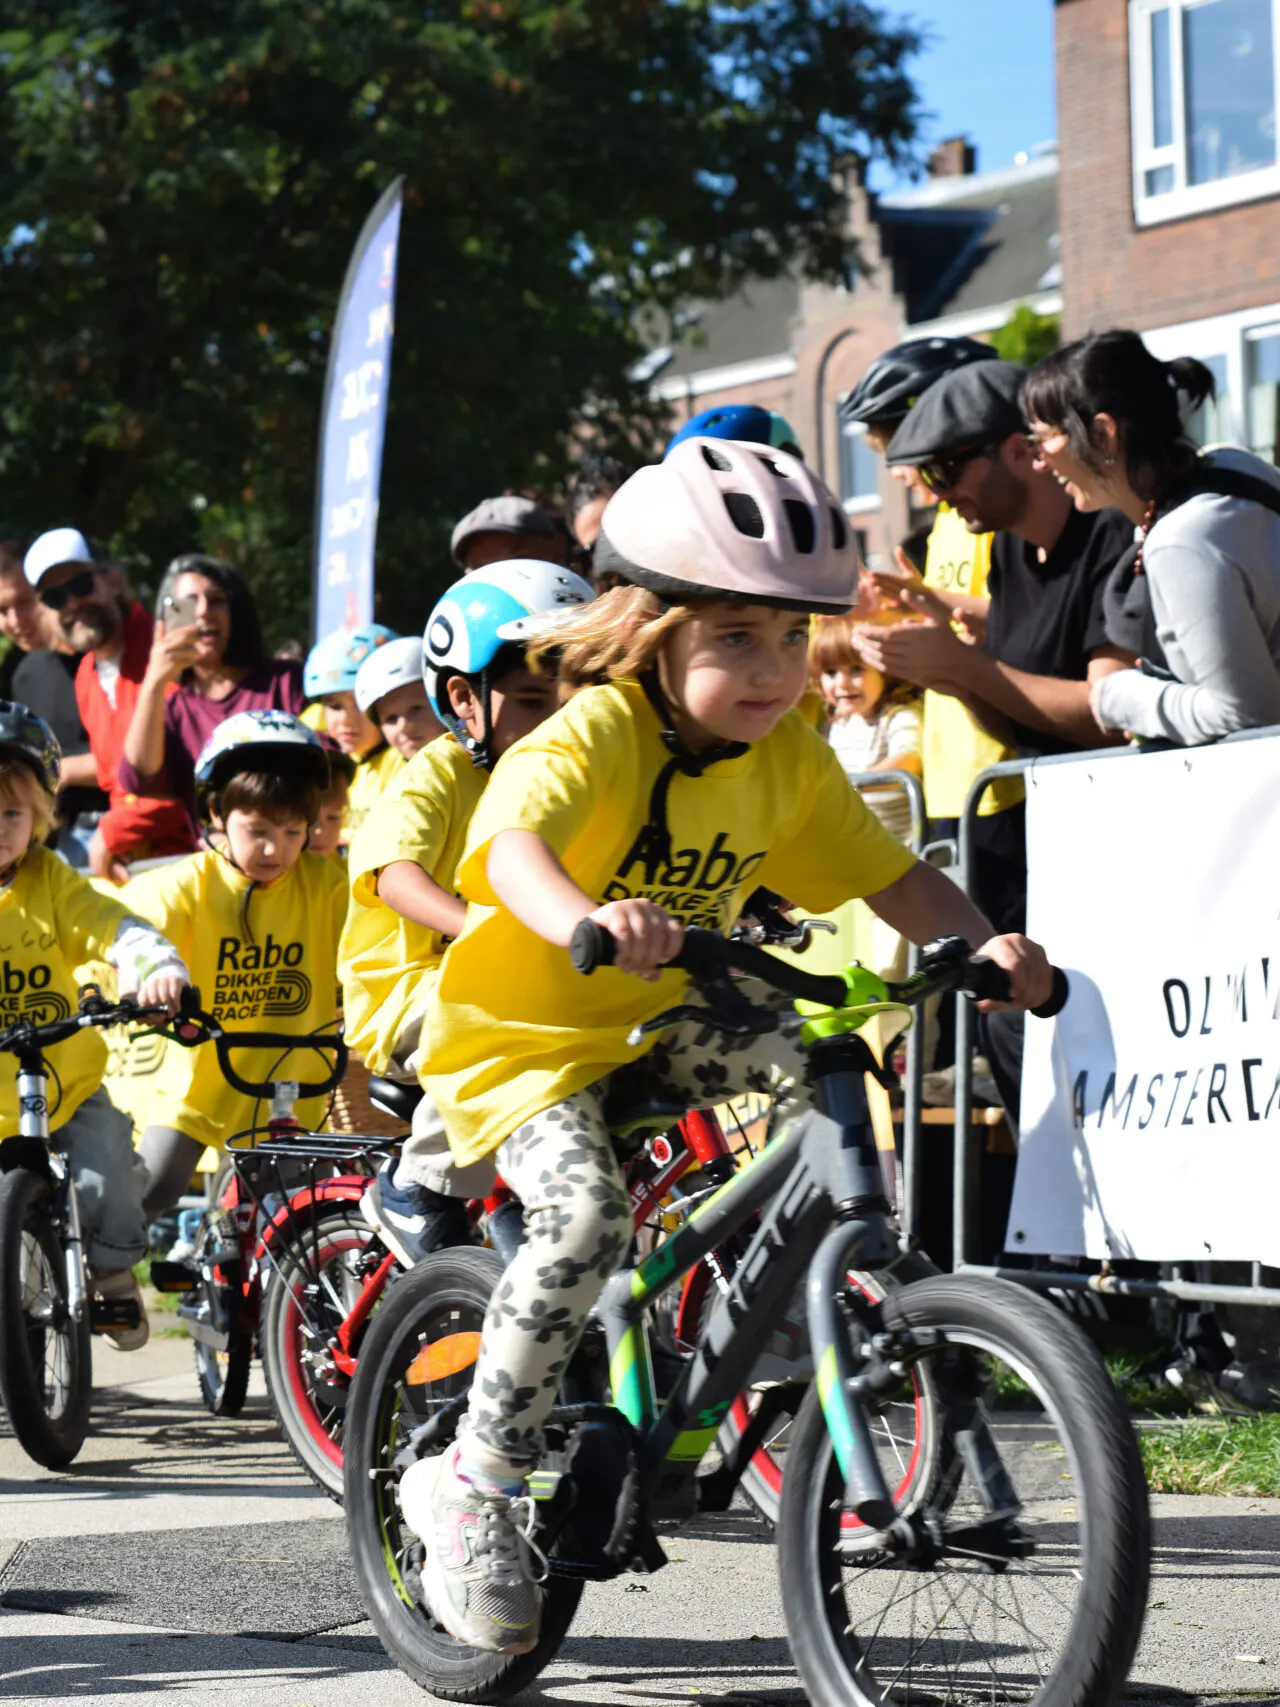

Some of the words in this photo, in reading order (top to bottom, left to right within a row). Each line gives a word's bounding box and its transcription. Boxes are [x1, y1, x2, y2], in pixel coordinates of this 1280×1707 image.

[217, 934, 303, 971] Rabo
[216, 972, 272, 988] DIKKE
[214, 986, 292, 1004] BANDEN
[211, 1004, 261, 1020] RACE
